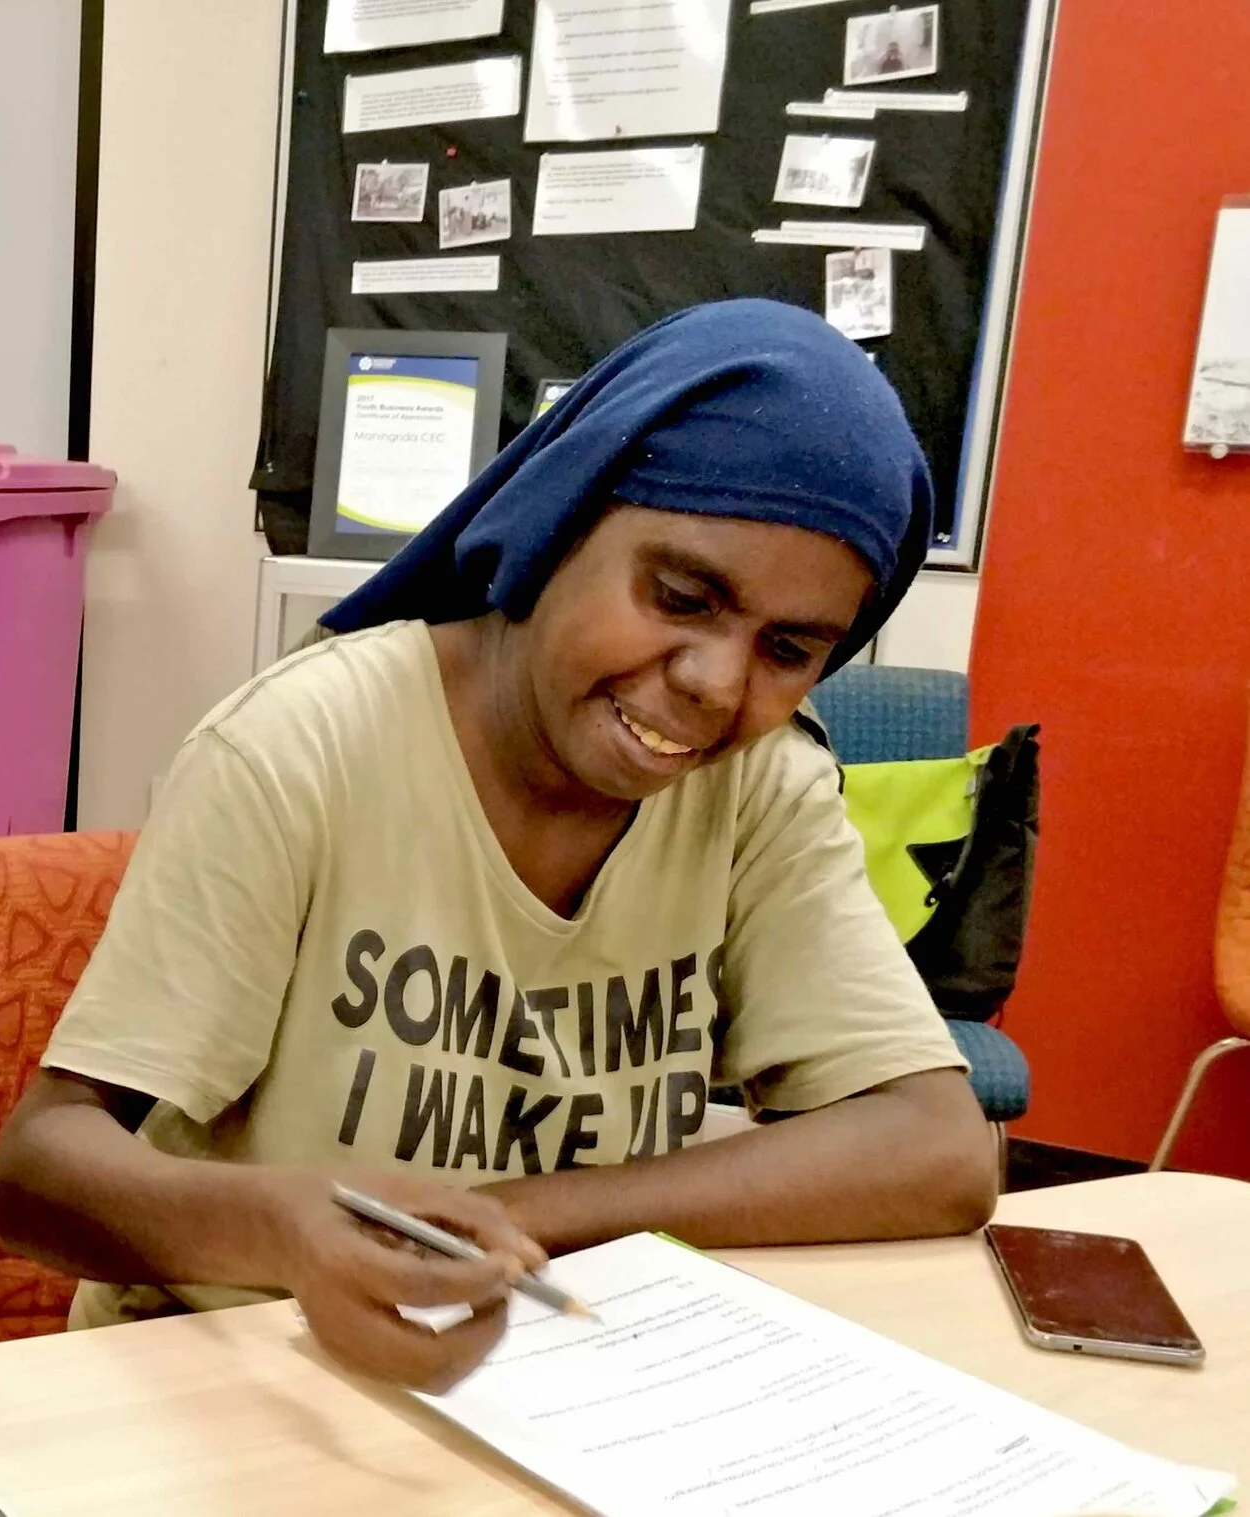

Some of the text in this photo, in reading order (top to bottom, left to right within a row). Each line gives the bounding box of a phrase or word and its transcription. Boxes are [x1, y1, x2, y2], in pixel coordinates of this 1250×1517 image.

[338, 1048, 707, 1175] I WAKE UP
